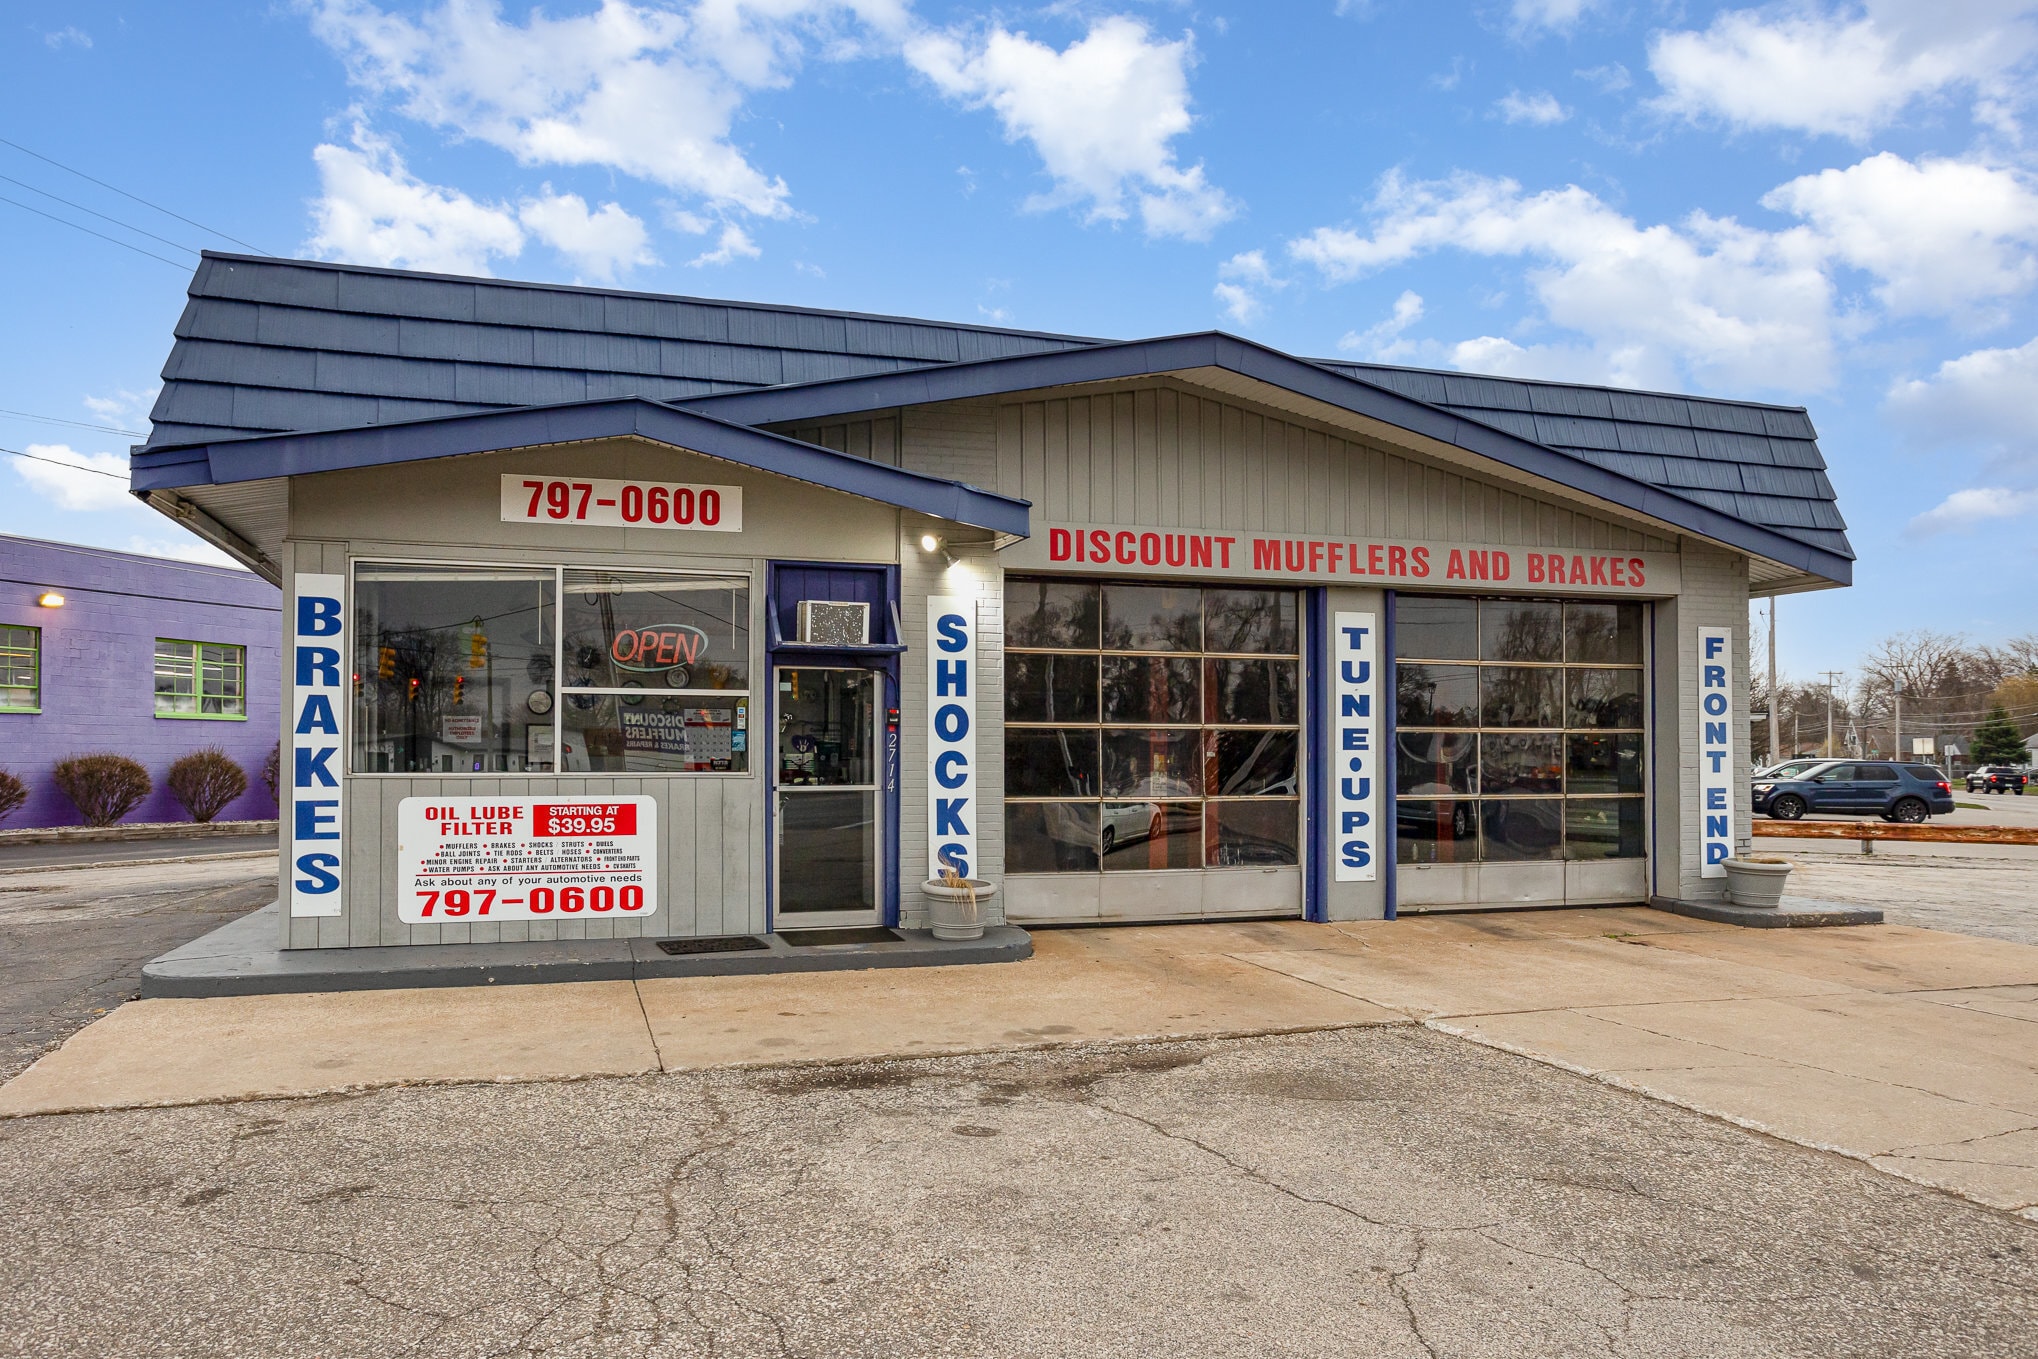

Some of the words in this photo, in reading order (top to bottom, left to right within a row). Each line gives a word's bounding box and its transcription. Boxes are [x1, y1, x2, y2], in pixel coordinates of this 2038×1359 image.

[522, 480, 721, 526] 797-0600
[1049, 527, 1236, 568] DISCOUNT
[1253, 538, 1430, 578] MUFFLERS
[1446, 549, 1510, 581] AND
[1527, 553, 1645, 587] BRAKES
[612, 629, 699, 665] OPEN
[1703, 637, 1728, 773] FRONT
[295, 595, 342, 895] BRAKES
[887, 733, 898, 793] 2714
[934, 613, 970, 879] SHOCKS
[425, 806, 460, 821] OIL
[470, 806, 524, 820] LUBE
[441, 821, 513, 836] FILTER
[547, 817, 616, 835] $39.95
[549, 806, 603, 816] STARTING
[605, 805, 620, 815] AT
[1706, 787, 1729, 865] END
[445, 842, 478, 850] MUFFLERS
[414, 878, 436, 887] Ask
[440, 877, 473, 887] about
[477, 878, 497, 887] any
[501, 876, 513, 885] of
[518, 876, 543, 886] your
[546, 874, 606, 884] automotive
[610, 873, 642, 883] needs
[415, 885, 644, 917] 797-0600
